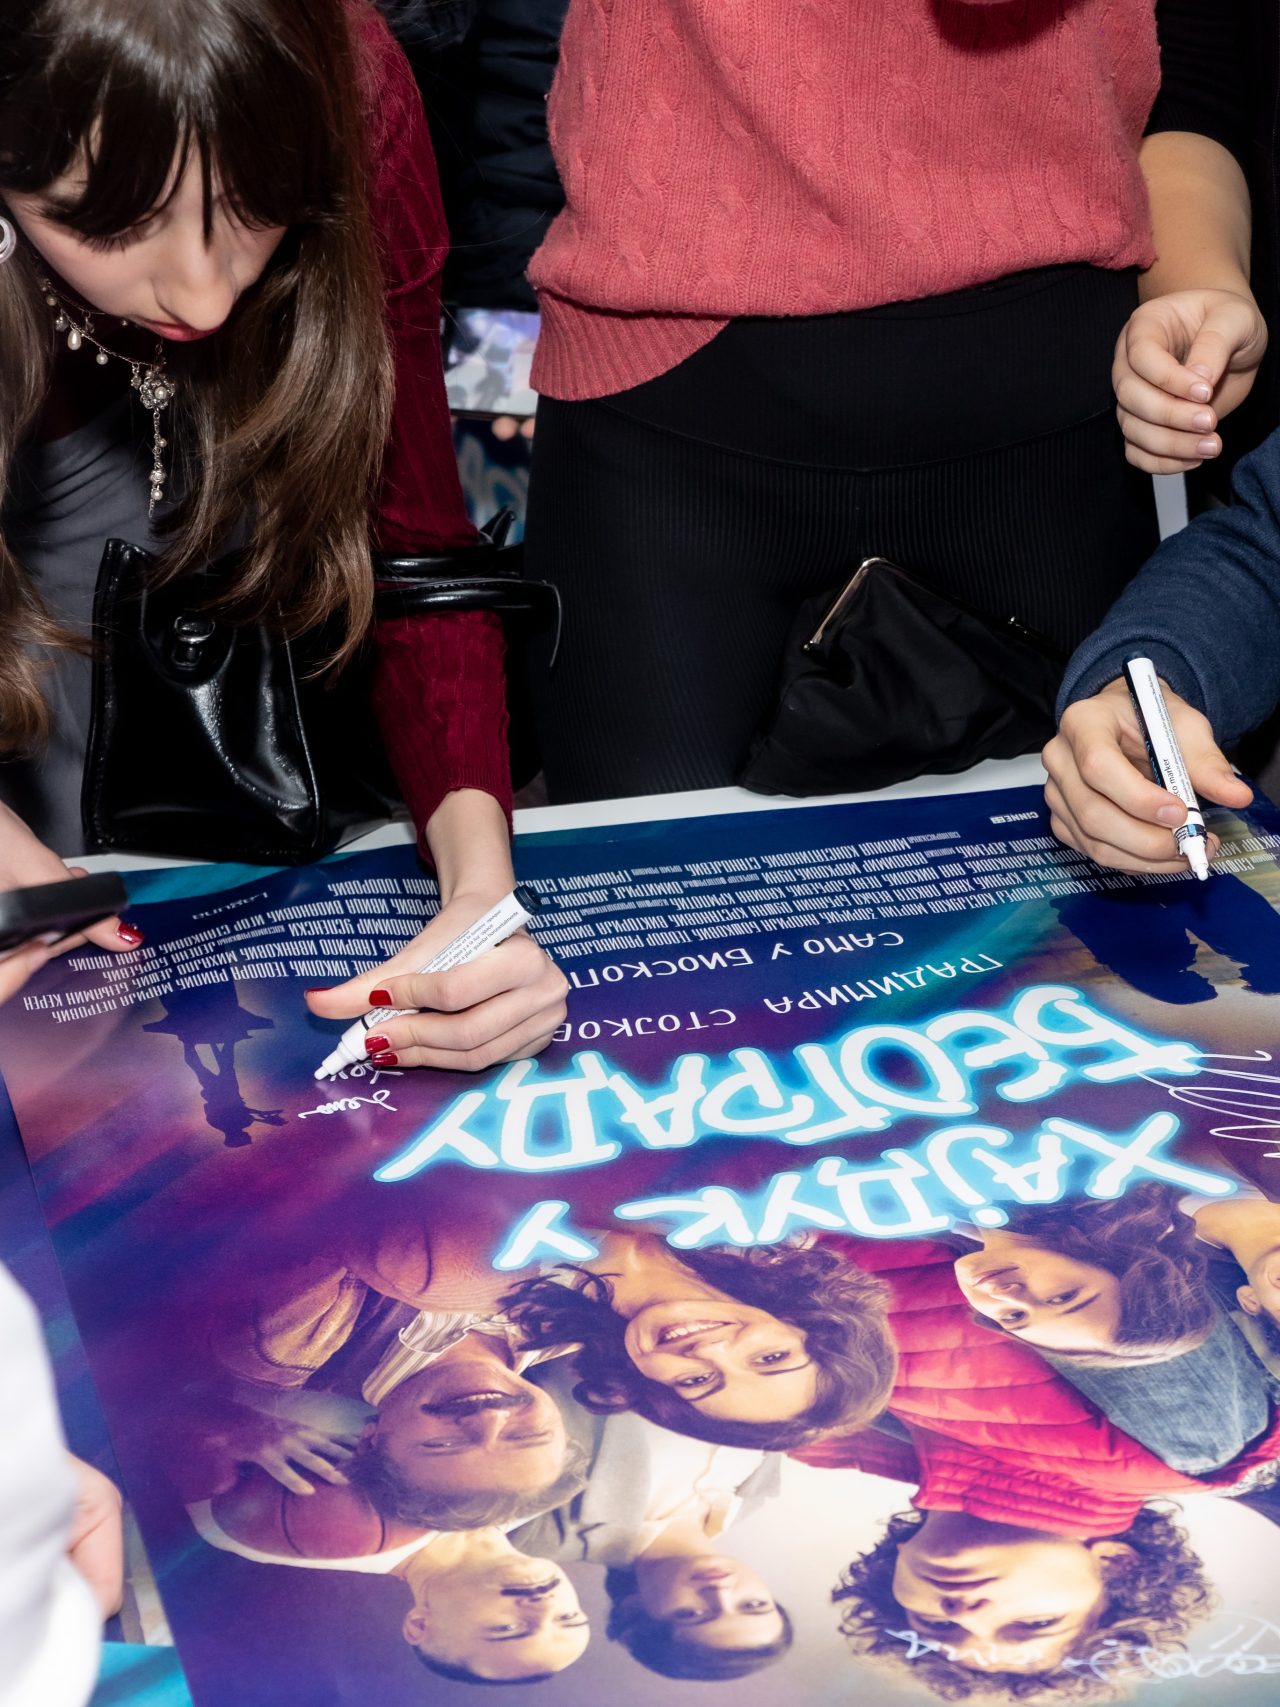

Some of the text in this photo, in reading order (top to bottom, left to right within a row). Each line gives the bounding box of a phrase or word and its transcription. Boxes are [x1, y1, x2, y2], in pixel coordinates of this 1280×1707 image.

[859, 837, 911, 858] МИЛИЦА
[954, 841, 1007, 858] ЈЕРЕМИЋ
[1008, 836, 1059, 852] НИКОЛА
[683, 856, 761, 877] СТАНОЈЕВИЋ
[794, 862, 862, 882] МАРКОВИЋ
[861, 851, 928, 873] ВЛАДИМИР
[938, 862, 966, 878] АНА
[556, 869, 632, 892] ГРАДИМИРА
[850, 874, 882, 891] ЛЕНА
[880, 865, 940, 886] НИКОЛИЋ
[972, 871, 1023, 890] КРУНИЋ
[1019, 863, 1091, 883] ДИМИТРИЈЕ
[327, 878, 438, 897] ИЛАН ТОДОРОВИЋ
[611, 880, 683, 900] ДИМИТРИЈЕ
[734, 886, 786, 904] КАЛИНА
[940, 878, 975, 895] ХАНА
[995, 885, 1043, 903] АНДРЕЈ
[344, 898, 390, 915] ИВИЦА
[552, 888, 609, 908] ЈОКОВИЋ
[669, 891, 735, 911] КРМПОТИЋ
[850, 889, 893, 907] ВЕЉКО
[266, 900, 343, 924] ВИДАНОВИЋ
[667, 906, 746, 928] КРСТАНОВИЋ
[749, 900, 793, 917] ДУШАН
[819, 907, 878, 926] ЗОРИЧИЋ
[876, 901, 928, 918] МАРТИН
[233, 914, 265, 932] ИГОР
[287, 918, 354, 937] УСПЕНСКИ
[356, 918, 423, 936] ВЛАДИМИР
[595, 915, 668, 936] ВИКТОРИЈА
[691, 920, 761, 941] БОШКОВИЋ
[760, 913, 820, 932] АНДРИЈА
[158, 923, 230, 956] СТАНКОВИЋ
[319, 938, 378, 956] ГАВРИЛО
[553, 935, 645, 959] РАДИВОЈЕВИЋ
[645, 930, 694, 947] ТЕОДОР
[803, 932, 904, 955] САМО
[115, 946, 156, 966] ДЕЈАН
[171, 940, 217, 964] ЈЕЛЕНА
[238, 939, 318, 962] ИВАНКОВИЋ
[771, 942, 793, 960] У
[176, 950, 238, 975] МИХАЈЛО
[229, 961, 289, 981] ТЕОДОРА
[289, 959, 352, 977] НИКОЛИЋ
[568, 948, 754, 990] БИОСКОП
[131, 967, 172, 993] ЈЕШИЋ
[22, 993, 62, 1011] КЕРЕН
[64, 980, 129, 1005] БЕЊАМИН
[119, 984, 174, 1007] МАРИЈА
[551, 954, 1003, 1042] ГРАДИМИРА СТОЈКОВ
[50, 998, 118, 1024] ПЕТРОВИЋ
[375, 986, 1199, 1181] БЕОГРАДУ
[494, 1114, 1234, 1270] ХАЈДУК У
